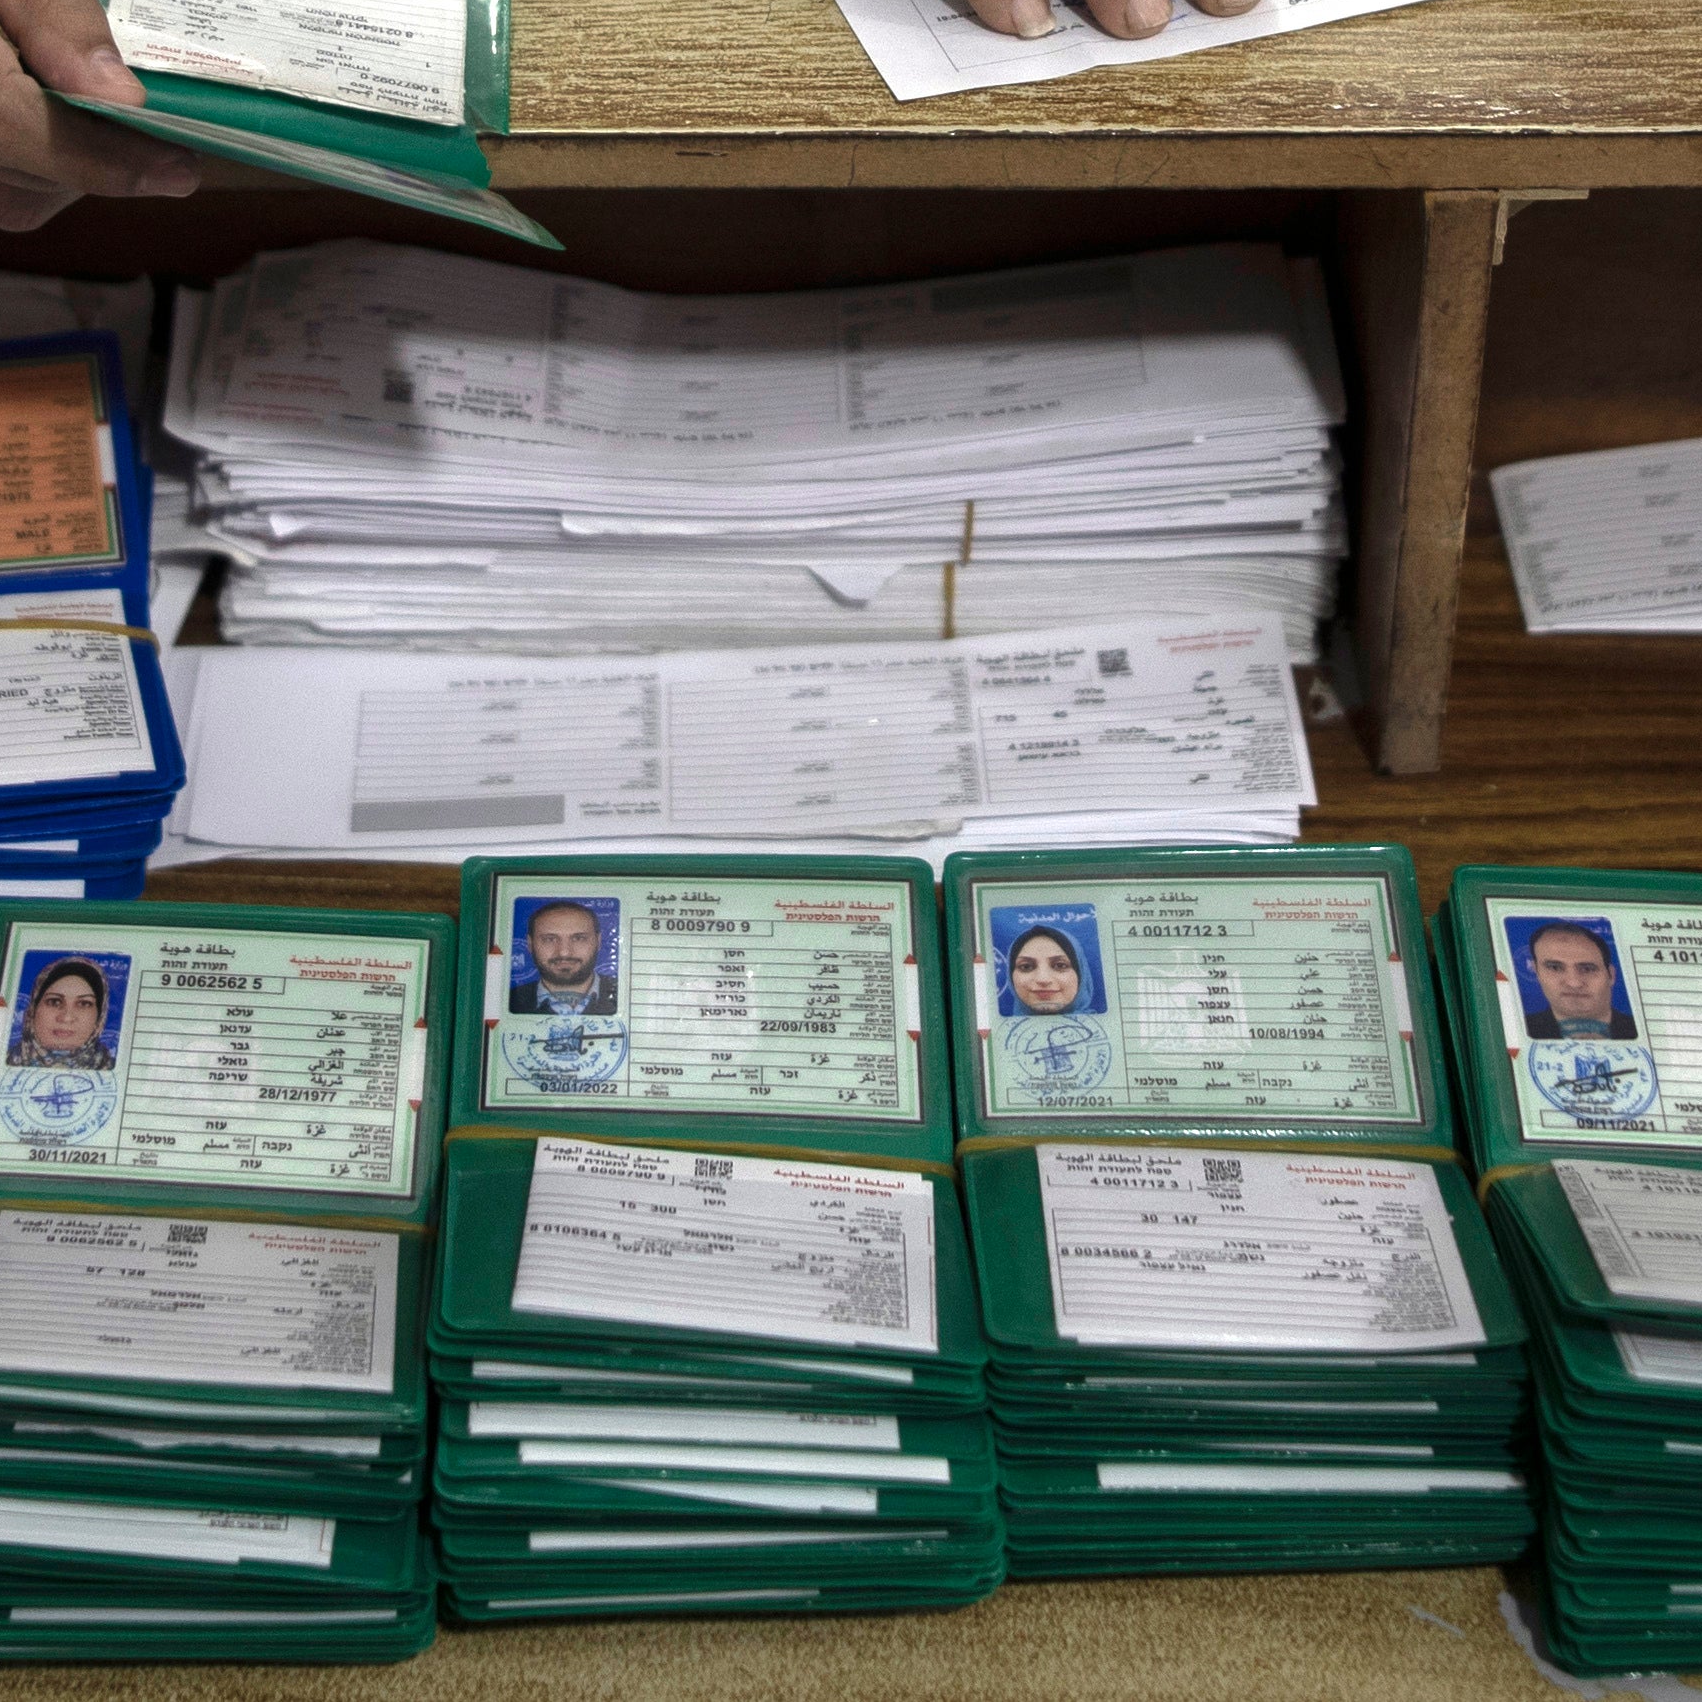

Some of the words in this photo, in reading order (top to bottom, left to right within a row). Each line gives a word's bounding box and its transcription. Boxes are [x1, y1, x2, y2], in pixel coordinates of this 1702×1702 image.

[646, 893, 677, 903] هوية
[682, 893, 721, 903] بطاقة
[1124, 893, 1156, 903] هوية
[1159, 893, 1198, 903] بطاقة
[1252, 898, 1322, 908] الفلسطينية
[1326, 899, 1371, 907] السلطة
[775, 899, 845, 910] الفلسطينية
[849, 900, 894, 910] السلطة
[649, 907, 675, 916] זהות
[679, 908, 715, 917] תעודת
[1129, 908, 1155, 917] זהות
[1159, 908, 1194, 918] תעודת
[1264, 910, 1321, 919] הפלסטינית
[786, 912, 841, 922] הפלסטינית
[651, 919, 661, 930] 8
[666, 919, 735, 932] 0009790
[741, 921, 751, 932] 9
[1641, 918, 1672, 930] هوية
[1128, 925, 1138, 936] 4
[1143, 925, 1213, 937] 0011712
[1218, 925, 1227, 936] 3
[1647, 935, 1673, 944] זהות
[160, 943, 193, 955] هوية
[197, 943, 236, 957] بطاقة
[724, 949, 745, 959] חסן
[813, 950, 839, 960] حسن
[1202, 954, 1225, 963] חנין
[1654, 950, 1663, 962] 4
[161, 959, 192, 968] זהות
[193, 962, 228, 971] תעודת
[289, 955, 362, 968] الفلسطينية
[367, 957, 412, 971] السلطة
[718, 964, 745, 973] זאפר
[298, 969, 360, 979] הפלסטינית
[1208, 970, 1227, 978] עלי
[161, 974, 171, 986] 9
[177, 975, 247, 989] 0062562
[252, 978, 263, 989] 5
[1206, 986, 1229, 995] חסן
[1198, 1000, 1230, 1009] עצפור
[226, 1007, 254, 1017] עולא
[220, 1024, 252, 1034] עדנאן
[760, 1020, 837, 1034] 22/09/1983
[1248, 1028, 1325, 1039] 10/08/1994
[230, 1041, 250, 1050] גבר
[217, 1056, 248, 1066] גזאלי
[208, 1071, 248, 1081] שריפה
[640, 1066, 683, 1076] מוסלמי
[779, 1070, 799, 1078] זכר
[1134, 1076, 1177, 1086] מוסלמי
[1262, 1077, 1292, 1087] נקבה
[540, 1083, 618, 1094] 03/01/2022
[259, 1087, 337, 1102] 28/12/1977
[1037, 1096, 1113, 1106] 12/07/2021
[131, 1134, 176, 1145] מוסלמי
[262, 1141, 293, 1151] נקבה
[29, 1149, 106, 1164] 30/11/2021
